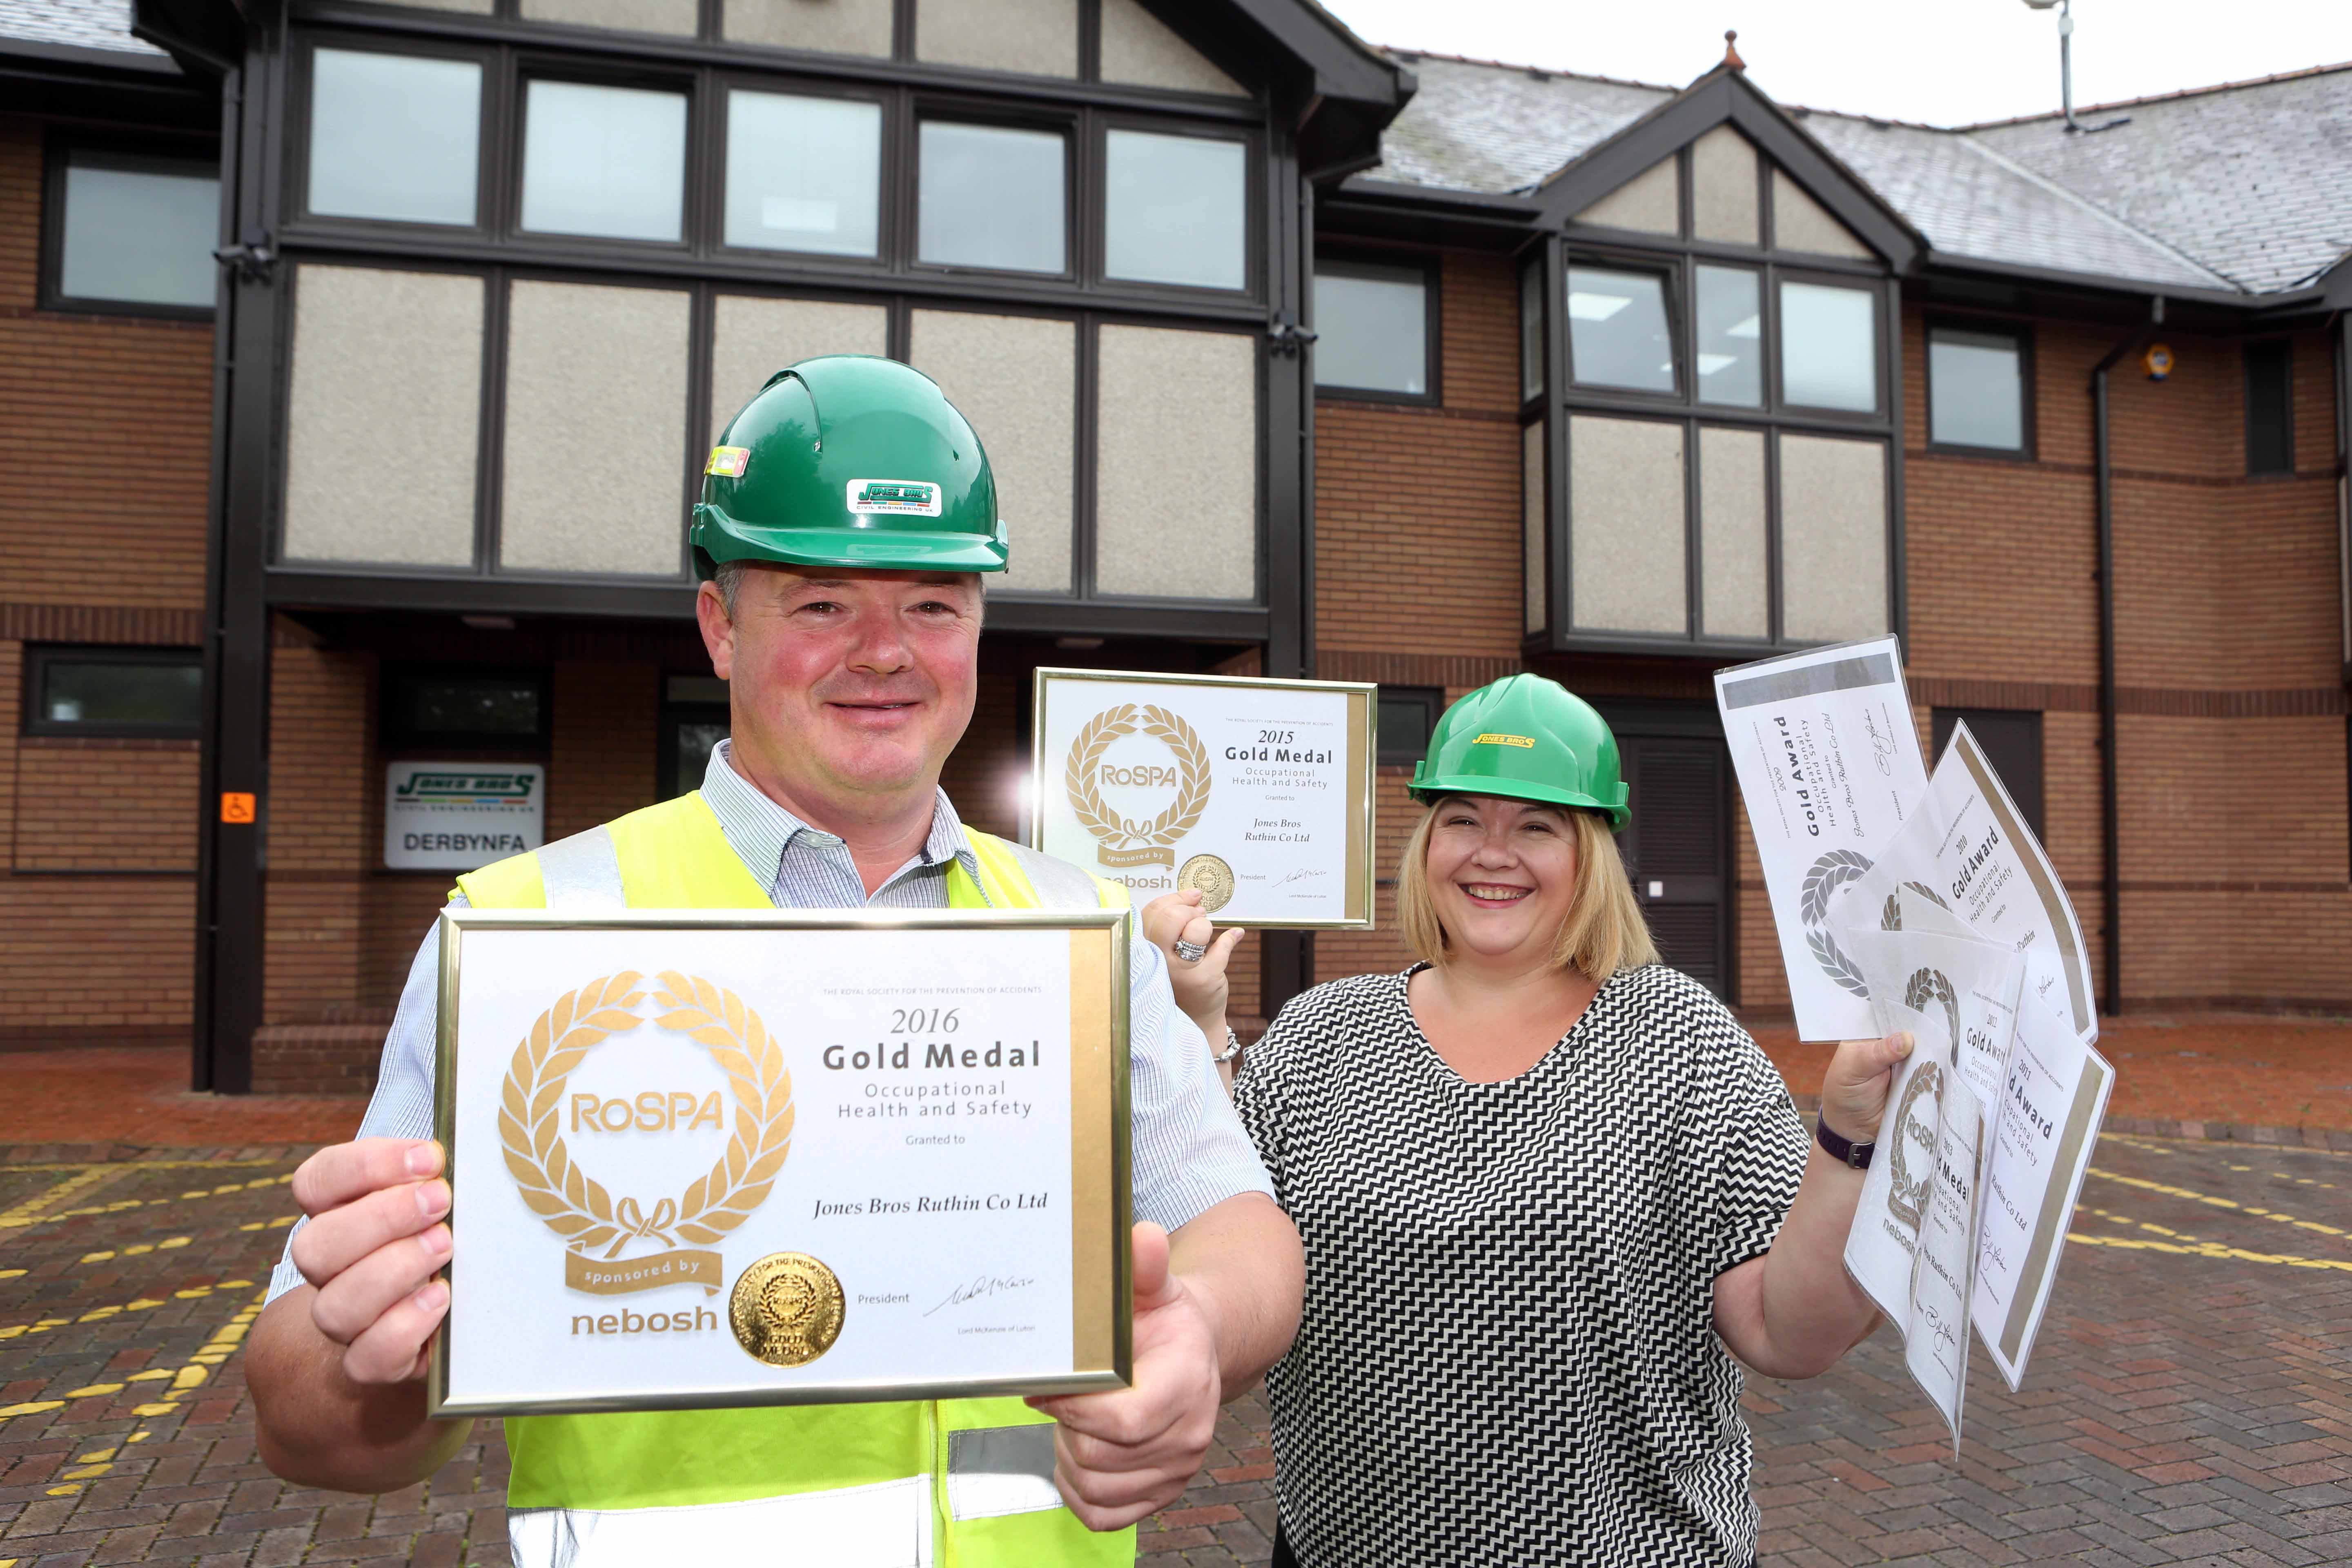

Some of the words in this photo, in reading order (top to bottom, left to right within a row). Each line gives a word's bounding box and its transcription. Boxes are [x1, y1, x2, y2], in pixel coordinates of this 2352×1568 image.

[858, 483, 900, 501] JONES
[1258, 730, 1294, 744] 2015
[1472, 734, 1505, 744] JONES
[1506, 737, 1535, 748] BROS
[1801, 719, 1816, 756] Safety
[1225, 747, 1268, 761] Gold
[1275, 749, 1332, 764] Medal
[1774, 717, 1804, 782] Award
[1101, 765, 1176, 787] RoSPA
[1245, 767, 1314, 777] Occupational
[1796, 735, 1824, 813] Occupational
[1813, 762, 1823, 782] and
[1827, 764, 1836, 788] Granted
[1835, 751, 1847, 782] Ruthin
[1232, 777, 1267, 785] Health
[1295, 779, 1327, 790] Safety
[1774, 767, 1786, 791] 2009
[1821, 788, 1836, 826] Health
[1845, 784, 1853, 807] Bros
[1892, 791, 1903, 820] President
[1253, 818, 1278, 829] Jones
[1281, 819, 1301, 828] Bros
[1797, 789, 1819, 836] Gold
[1852, 810, 1864, 837] Jones
[404, 833, 526, 851] DERBYNFA
[1245, 832, 1276, 841] Ruthin
[1279, 833, 1291, 842] Co
[1294, 833, 1310, 842] Ltd
[1956, 835, 1967, 855] 2010
[1107, 853, 1149, 862] sponsored
[1952, 864, 1971, 899] Gold
[1969, 825, 1999, 875] Award
[1103, 875, 1172, 889] ebosh
[1969, 860, 2000, 905] Occupational
[1970, 900, 1986, 924] Health
[1985, 887, 1995, 903] and
[1994, 866, 2013, 891] Safety
[2017, 929, 2035, 953] Ruthin
[890, 1007, 960, 1033] 2016
[1987, 1013, 1998, 1028] 2012
[1967, 1027, 1986, 1052] Gold
[823, 1043, 909, 1070] Gold
[924, 1040, 1038, 1068] Medal
[1964, 1065, 1979, 1084] Health
[2019, 1059, 2031, 1082] 2011
[865, 1080, 1005, 1100] Occupational
[571, 1091, 723, 1132] RoSPA
[839, 1102, 908, 1118] Health
[919, 1101, 956, 1116] and
[967, 1100, 1032, 1118] Safety
[2005, 1099, 2034, 1143] cupational
[2015, 1085, 2053, 1140] Award
[905, 1134, 951, 1146] Granted
[954, 1134, 965, 1144] to
[1944, 1138, 1953, 1156] 2013
[2007, 1119, 2016, 1137] and
[2017, 1134, 2038, 1167] Safety
[1942, 1161, 1969, 1205] Medal
[813, 1199, 862, 1220] Jones
[869, 1198, 910, 1214] Bros
[917, 1195, 980, 1212] Ruthin
[986, 1194, 1011, 1210] Co
[1017, 1192, 1048, 1209] Ltd
[1991, 1173, 2006, 1204] Ruthin
[2006, 1200, 2014, 1216] Co
[2015, 1211, 2028, 1232] Ltd
[1938, 1198, 1947, 1213] and
[1949, 1209, 1964, 1236] Safety
[1883, 1217, 1915, 1259] nebosh
[585, 1261, 671, 1284] sponsored
[679, 1260, 699, 1274] by
[1931, 1255, 1948, 1282] Ruthin
[1949, 1276, 1956, 1290] Co
[858, 1293, 909, 1305] President
[571, 1306, 717, 1335] nebosh
